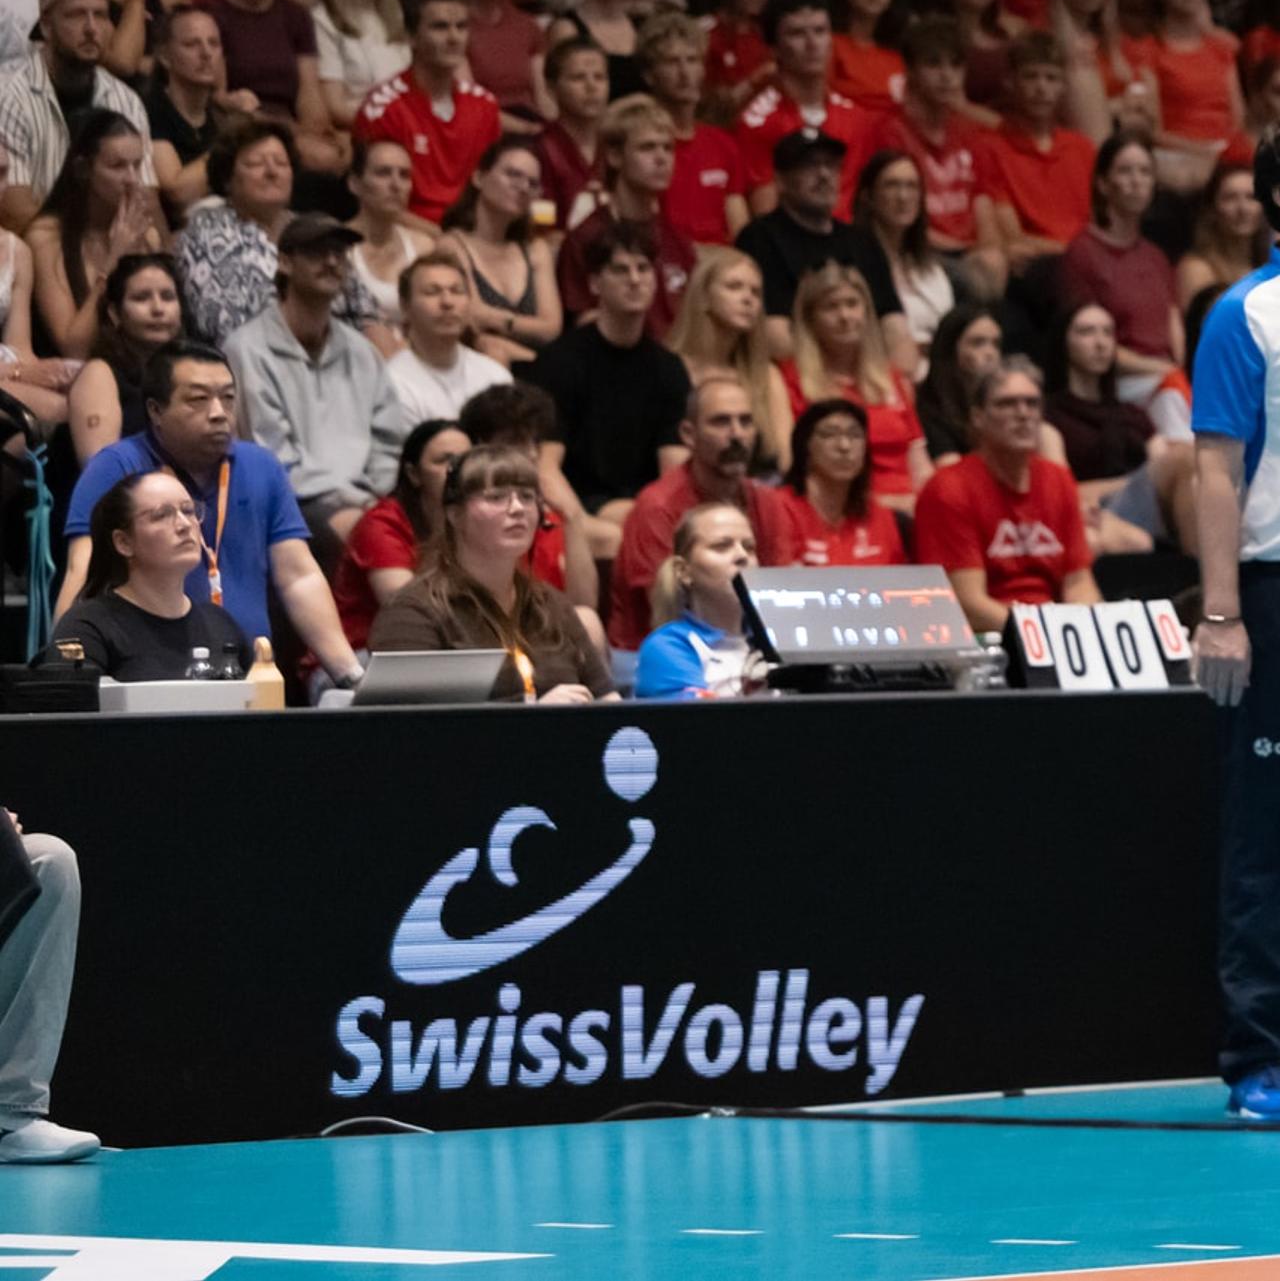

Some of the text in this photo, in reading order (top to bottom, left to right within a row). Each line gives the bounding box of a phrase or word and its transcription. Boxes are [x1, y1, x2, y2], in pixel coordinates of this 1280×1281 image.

[1022, 619, 1044, 661] 0
[1061, 623, 1087, 677] 0
[1116, 621, 1142, 675] 0
[1157, 614, 1182, 653] 0
[329, 968, 926, 1098] SwissVolley
